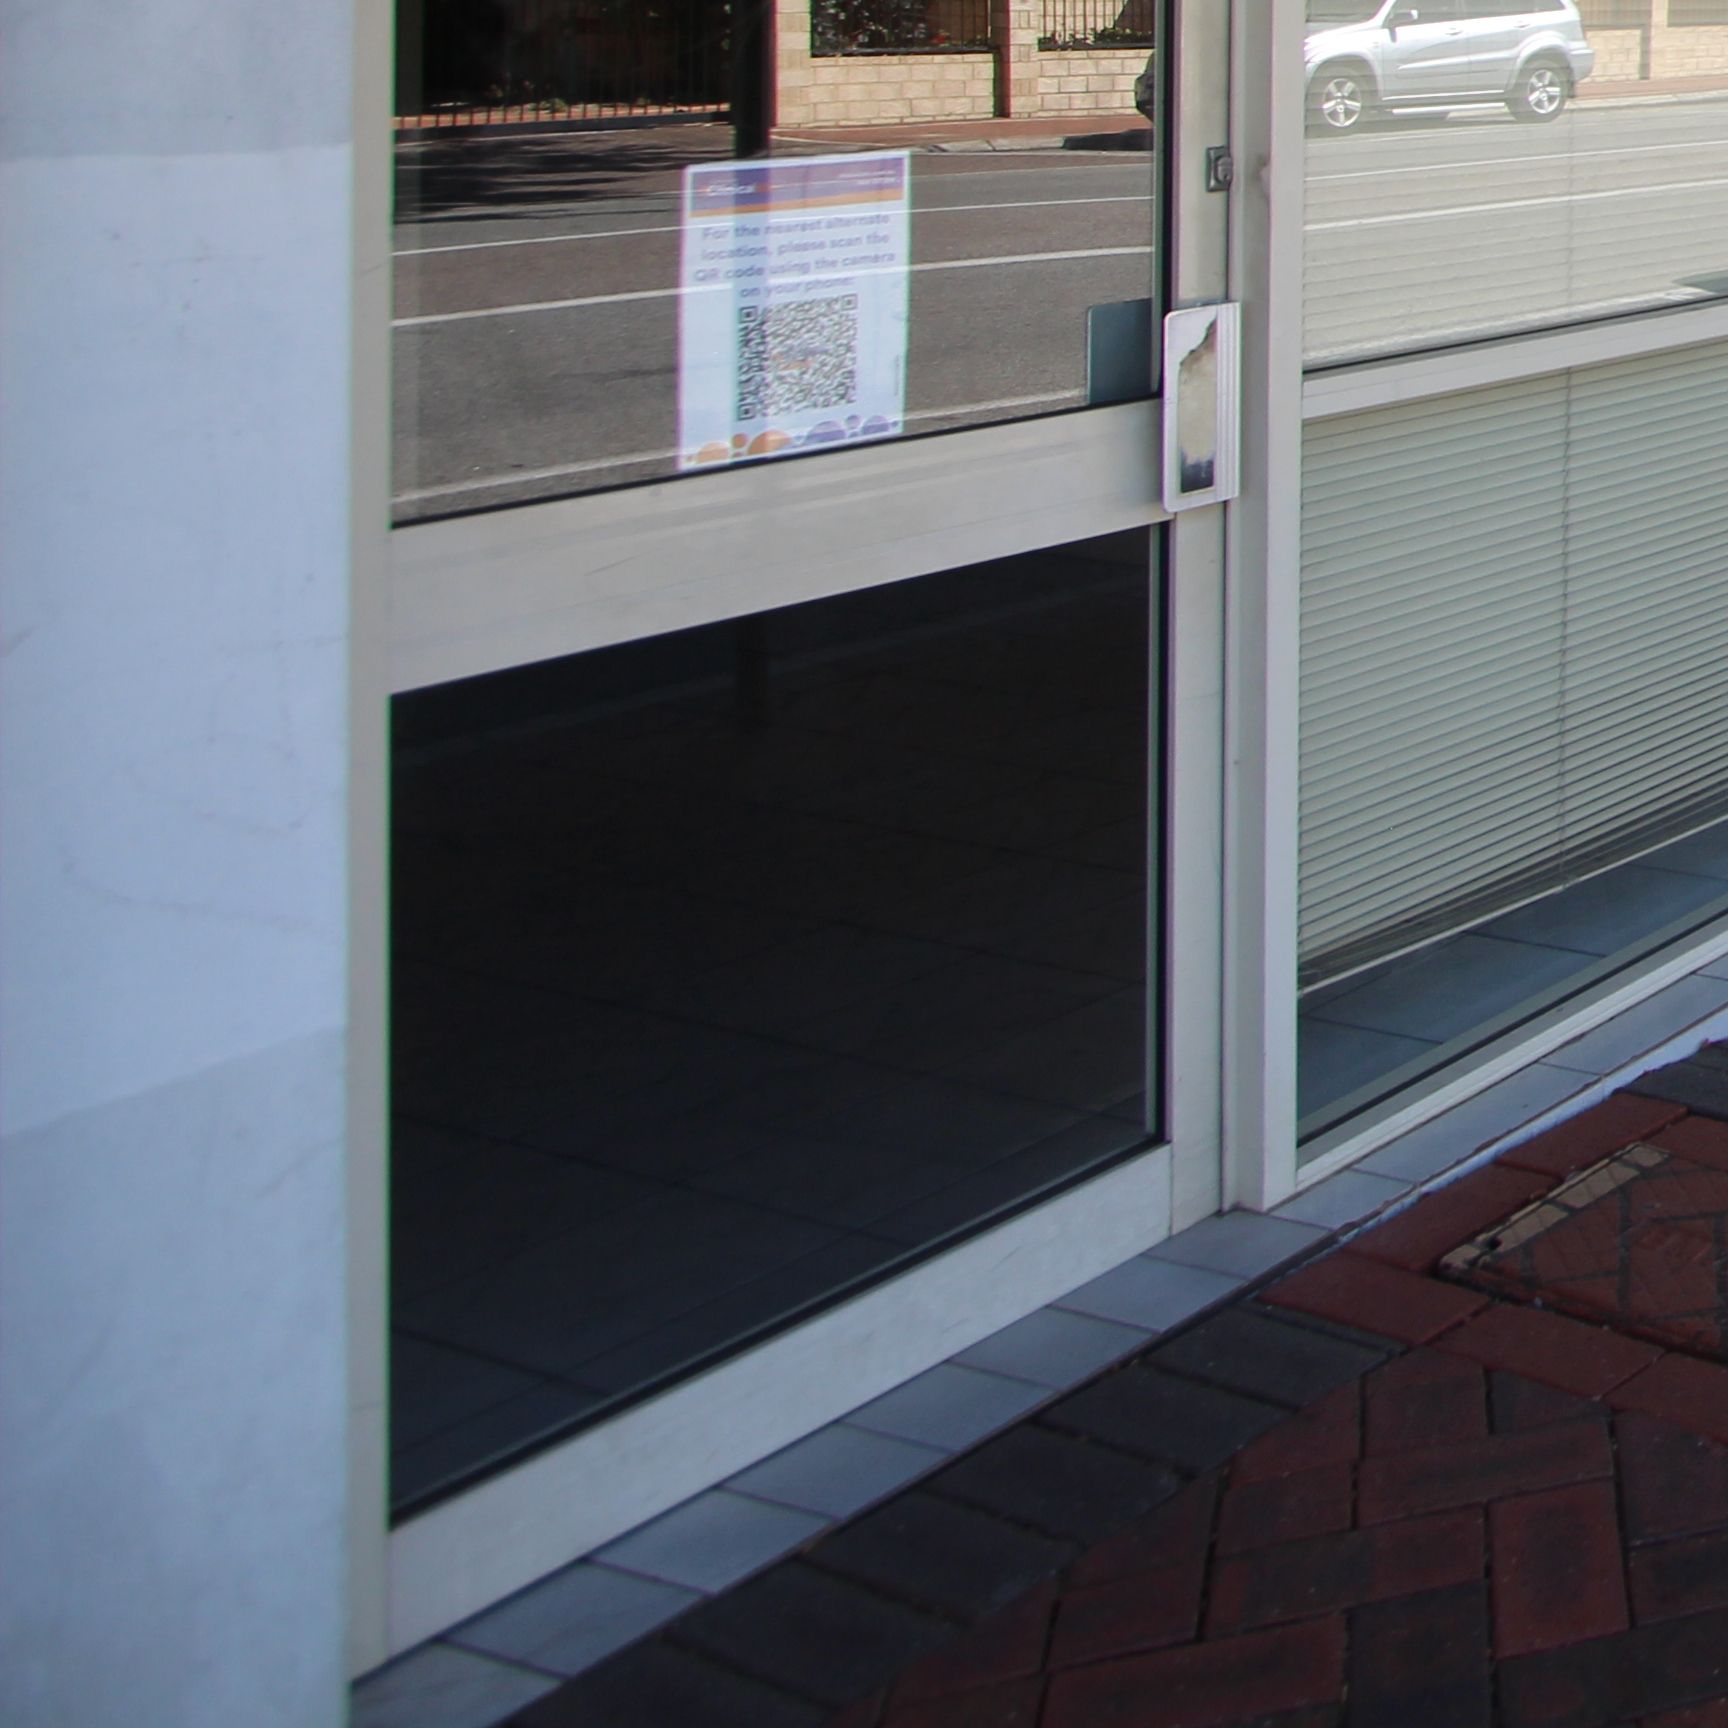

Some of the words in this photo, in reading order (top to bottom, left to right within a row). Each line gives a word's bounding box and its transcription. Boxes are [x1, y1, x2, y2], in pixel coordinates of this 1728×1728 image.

[703, 227, 730, 240] For
[734, 224, 760, 237] the
[764, 221, 822, 235] nearest
[777, 240, 827, 256] please
[829, 236, 863, 249] scan
[866, 232, 890, 245] the
[723, 265, 764, 279] code
[768, 262, 812, 276] using
[815, 257, 838, 270] the
[841, 253, 896, 266] camera
[739, 287, 761, 298] on
